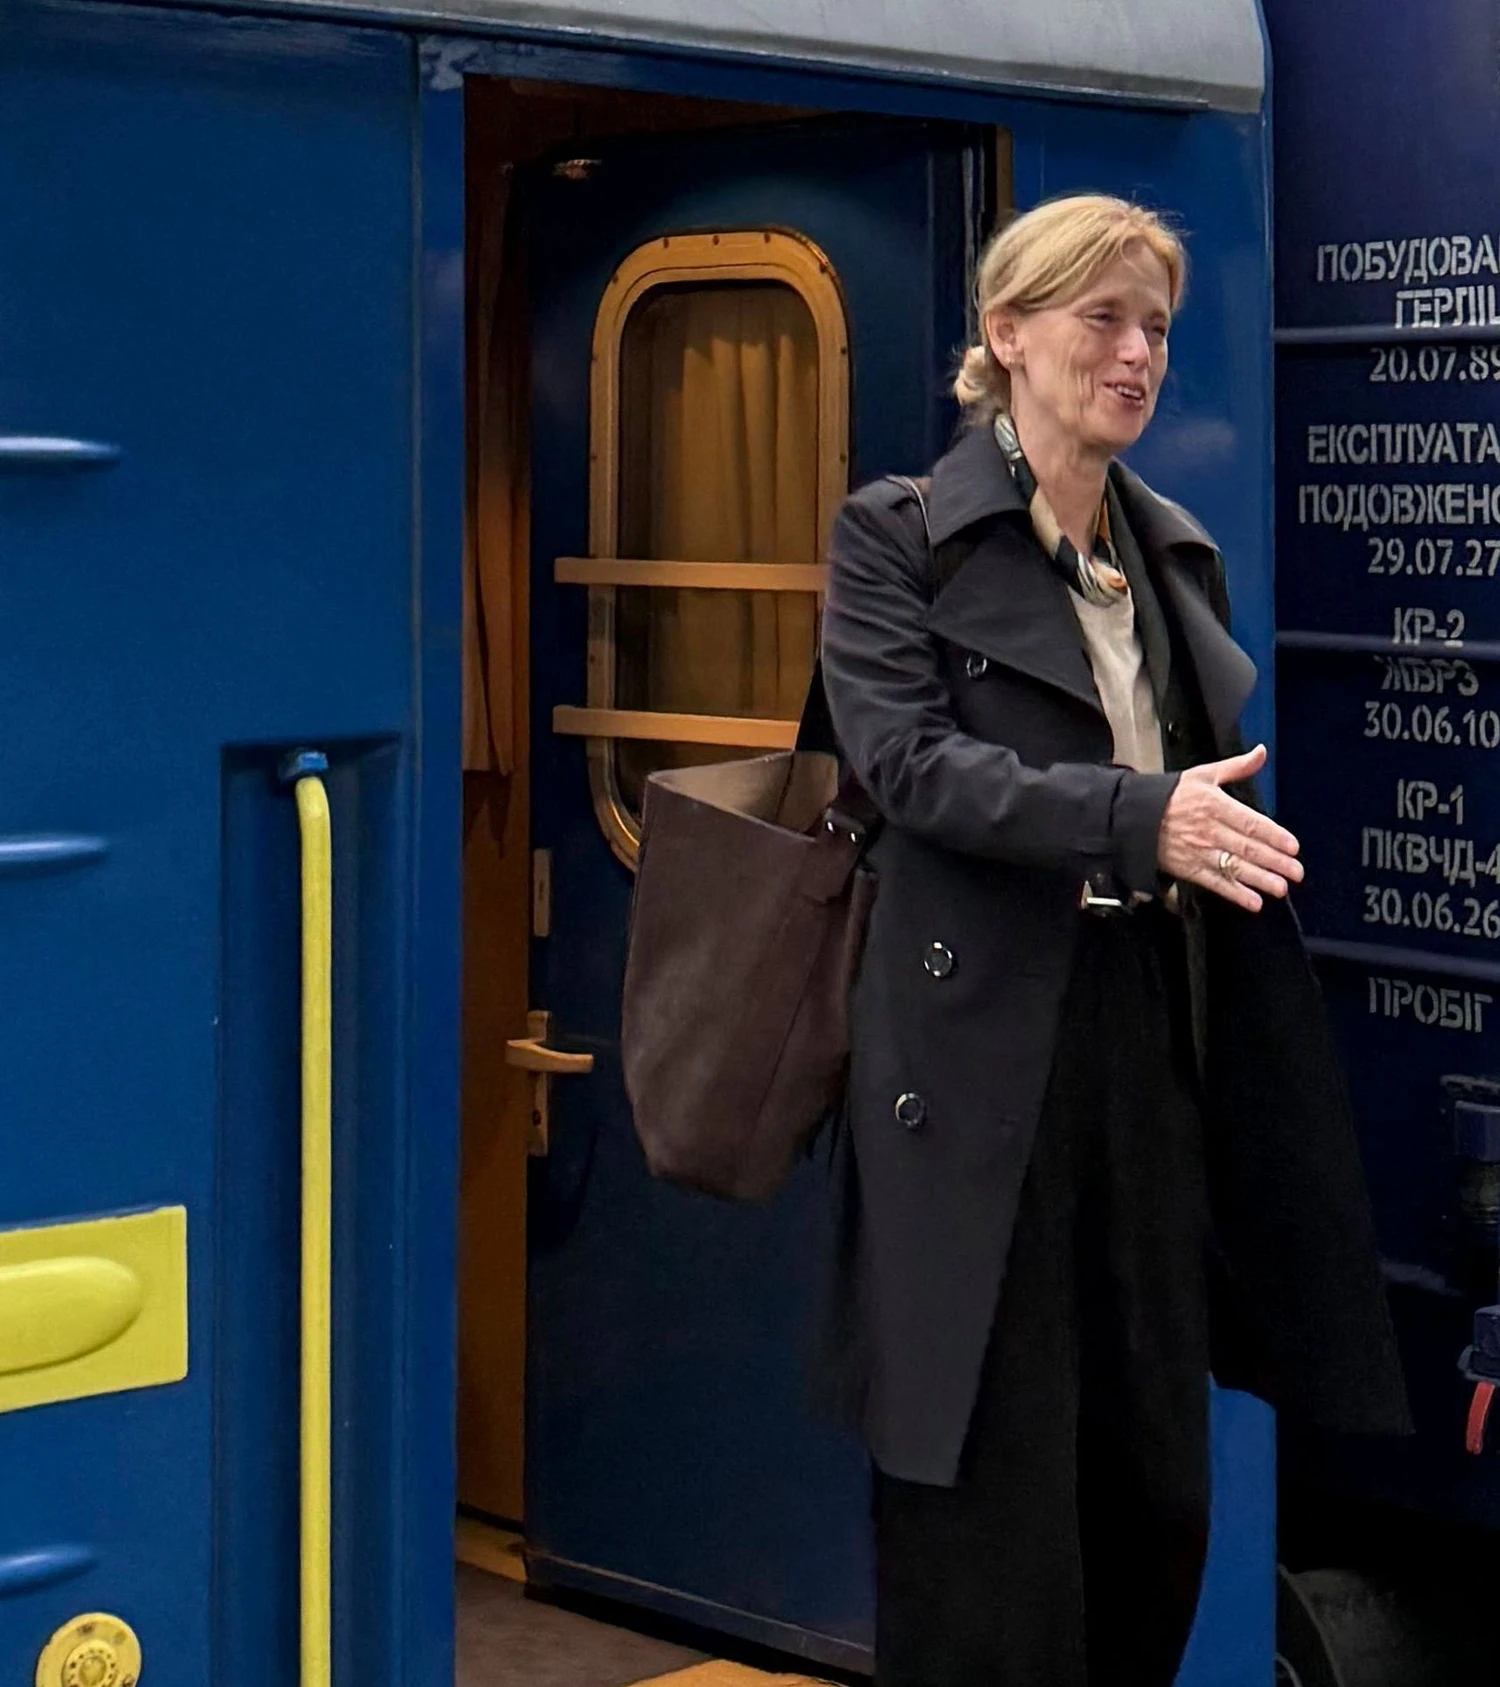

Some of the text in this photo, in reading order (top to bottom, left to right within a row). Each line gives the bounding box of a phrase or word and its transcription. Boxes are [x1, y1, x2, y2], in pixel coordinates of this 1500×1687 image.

[1393, 607, 1465, 648] КР-2
[1363, 701, 1500, 748] 30.06.10
[1396, 778, 1464, 826] КР-1
[1367, 977, 1494, 1033] ПРОБІГ
